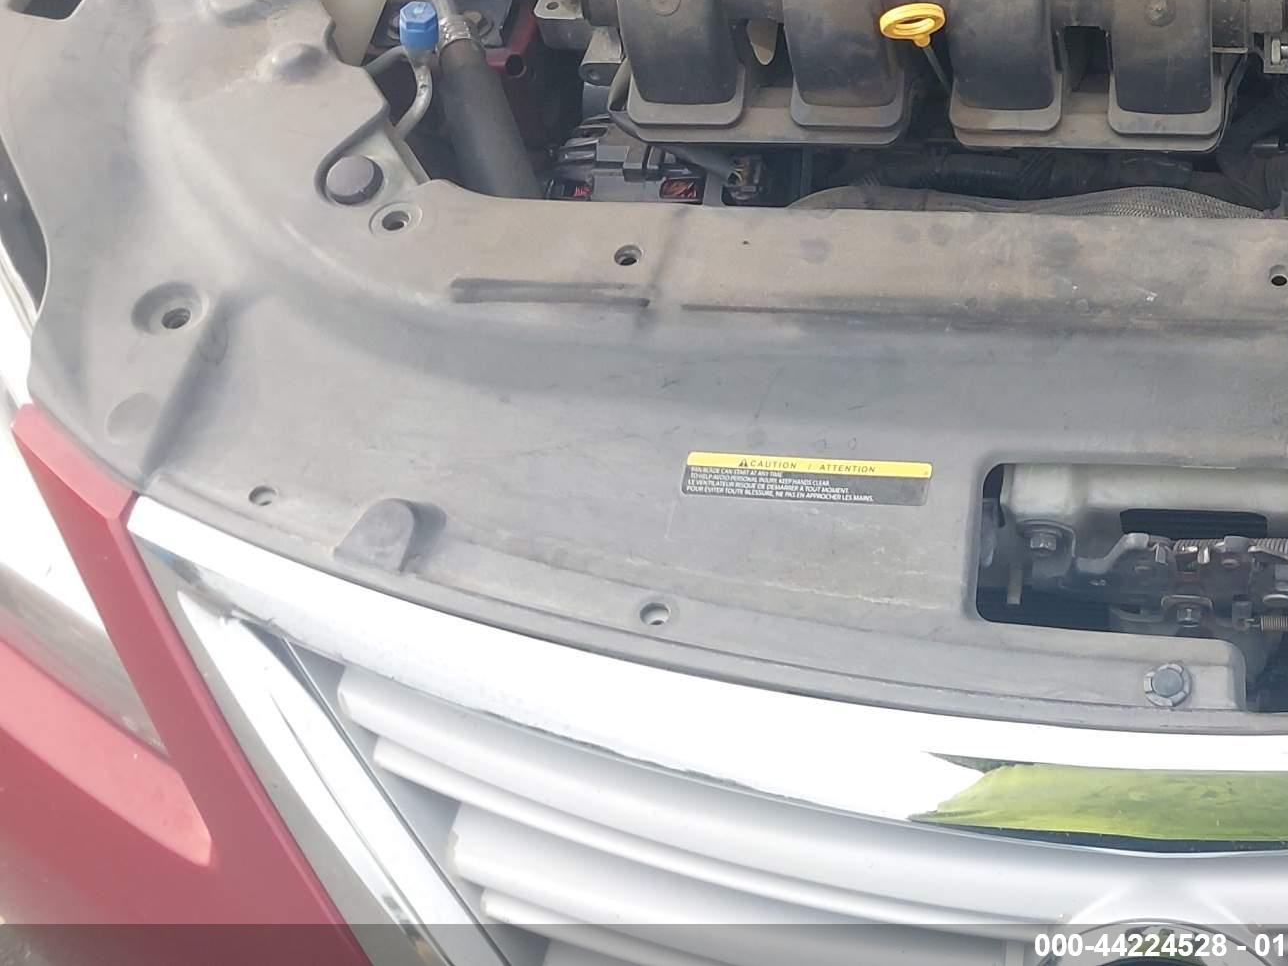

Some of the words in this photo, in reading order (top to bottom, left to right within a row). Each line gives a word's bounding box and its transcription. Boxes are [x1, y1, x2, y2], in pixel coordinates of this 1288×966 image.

[750, 460, 797, 468] CAUTION
[819, 464, 876, 473] ATTENTION
[805, 493, 840, 501] APPROCHER
